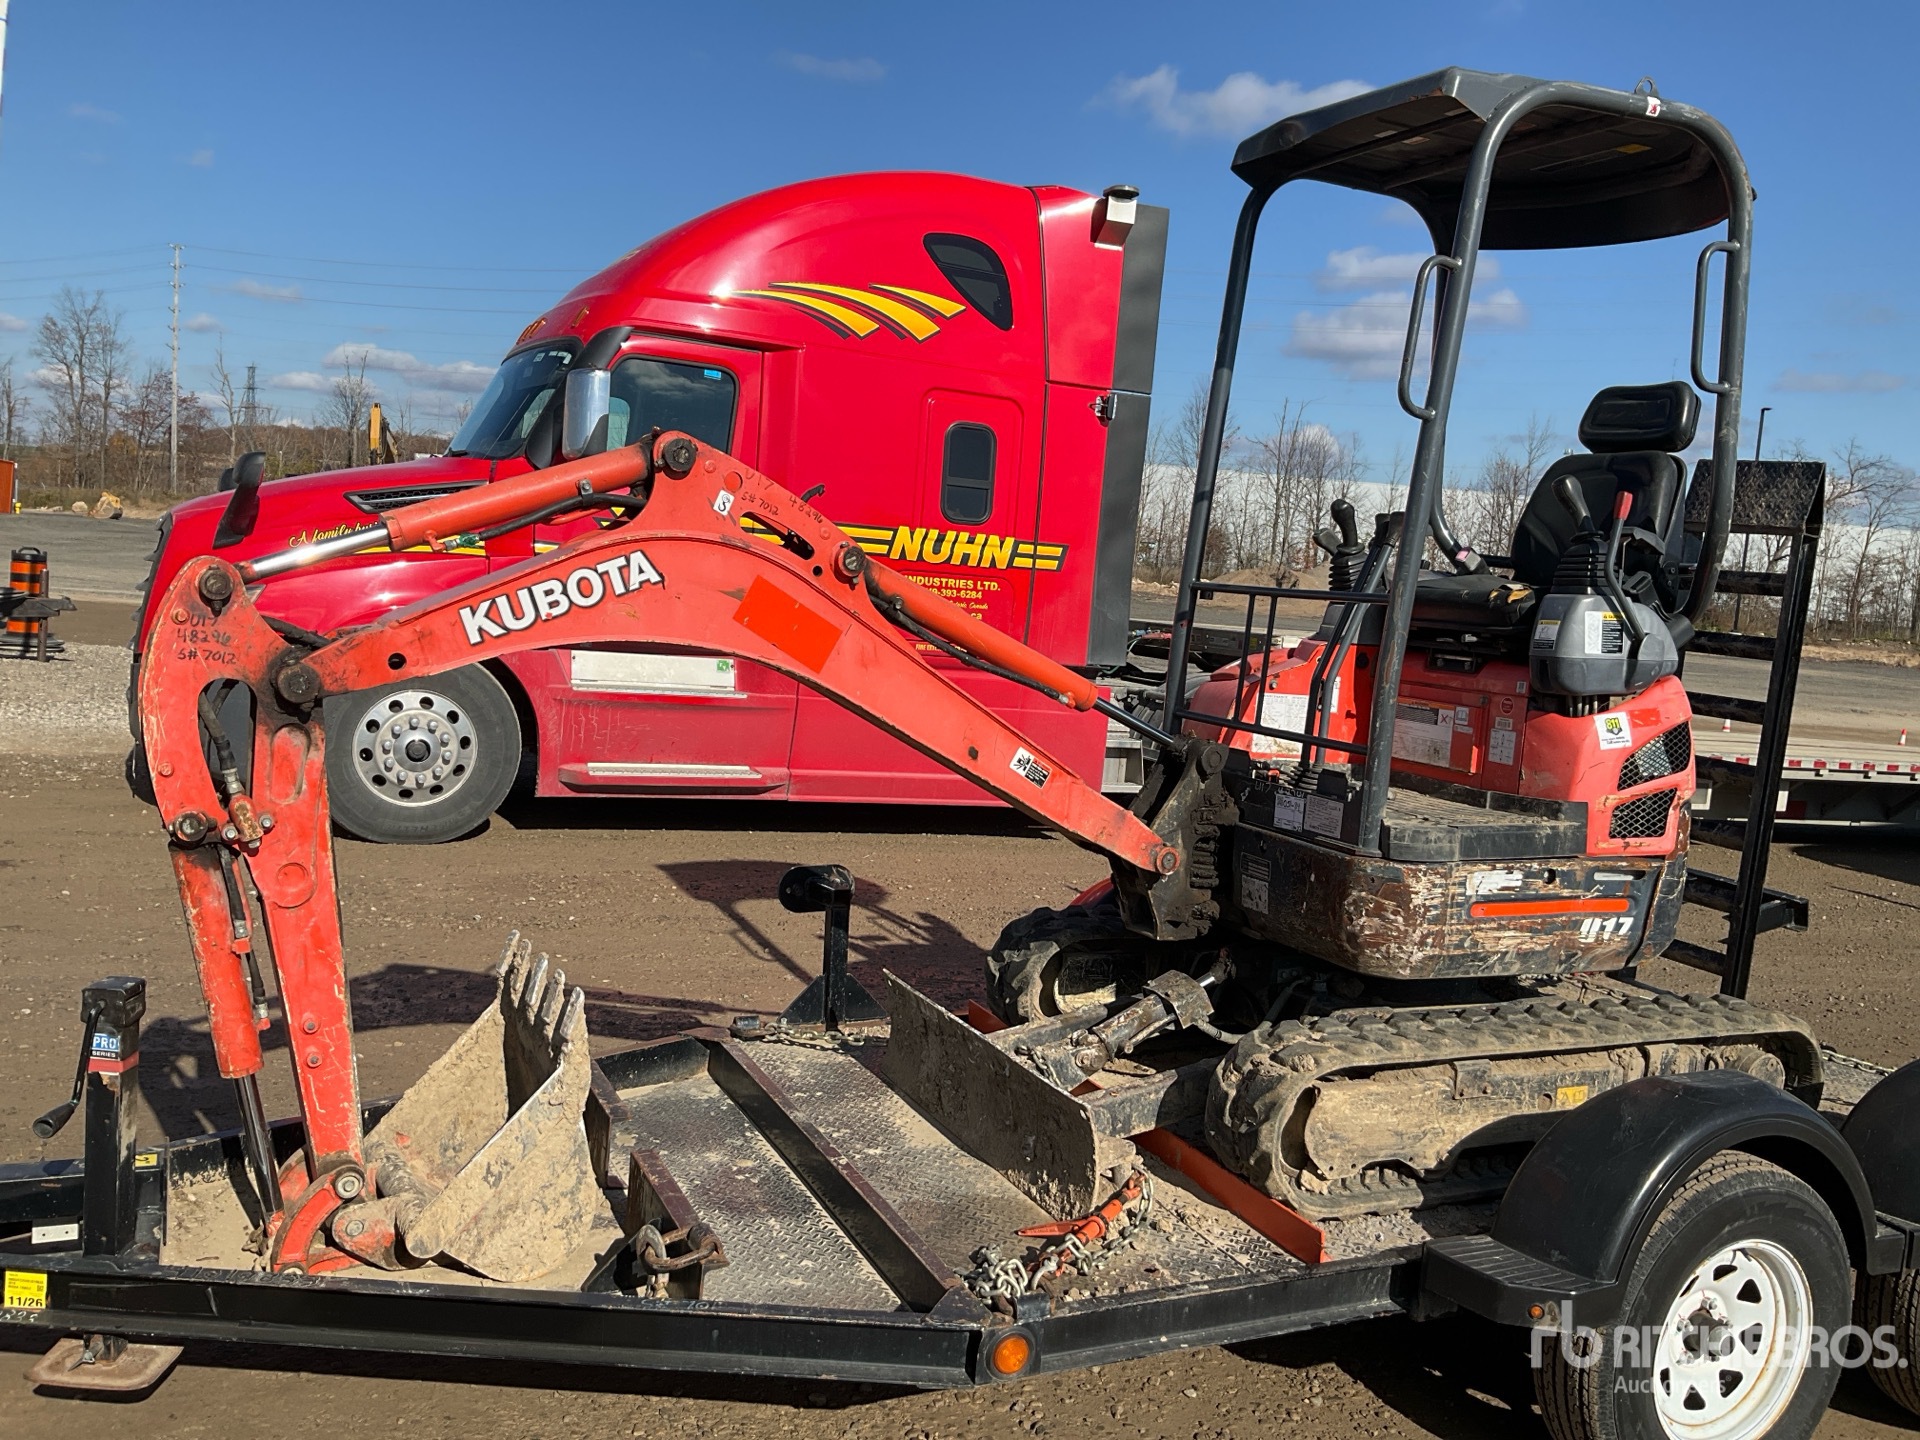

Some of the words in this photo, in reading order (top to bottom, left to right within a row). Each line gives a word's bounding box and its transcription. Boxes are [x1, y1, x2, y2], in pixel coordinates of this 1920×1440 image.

[759, 499, 779, 516] 7012
[889, 525, 1015, 569] NUHN
[976, 580, 1001, 591] LTD.
[458, 550, 663, 646] KUBOTA
[202, 648, 237, 664] 7012
[1605, 717, 1621, 729] 811
[92, 1036, 117, 1049] PRO
[8, 1295, 43, 1307] 11/26
